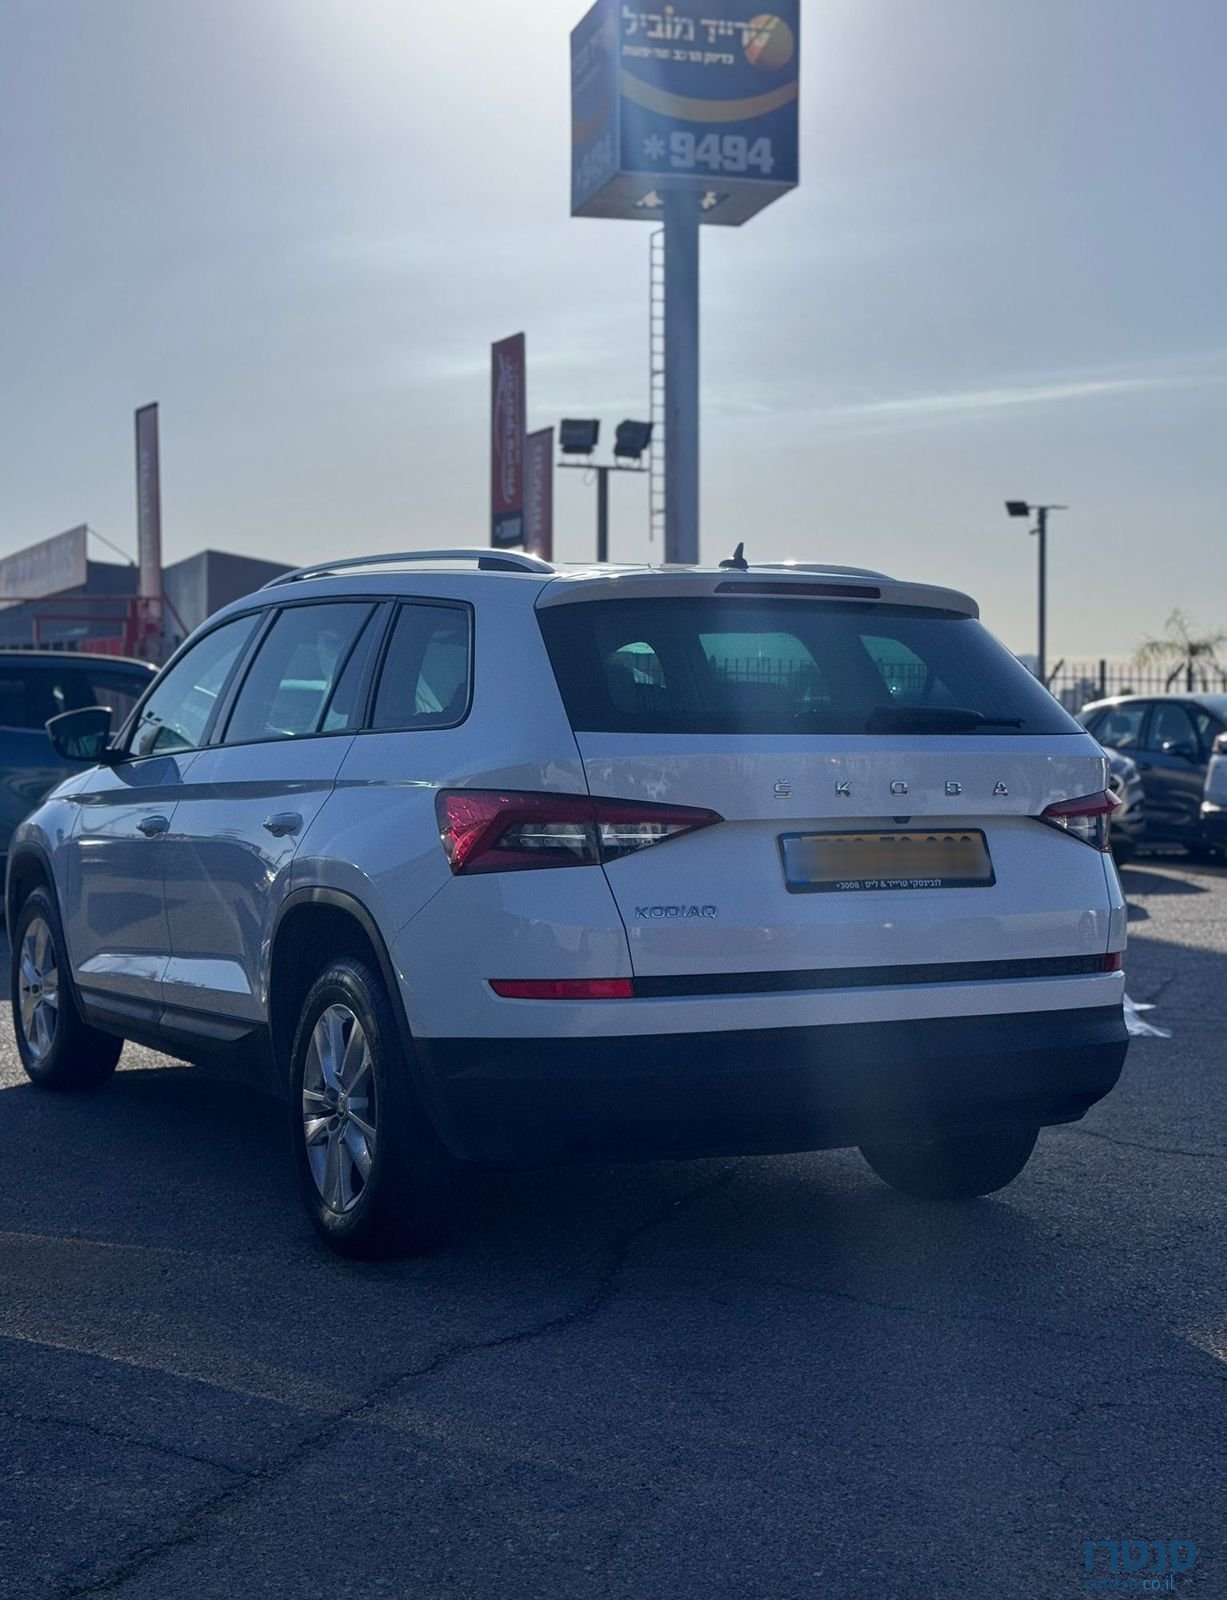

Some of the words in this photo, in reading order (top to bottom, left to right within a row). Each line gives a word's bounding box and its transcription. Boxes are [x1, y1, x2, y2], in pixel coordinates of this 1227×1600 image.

[622, 5, 695, 42] מוביל
[773, 778, 1010, 799] ŠKODA
[887, 880, 909, 888] טרייד
[910, 879, 942, 888] לובינסקי
[635, 905, 718, 919] KODIAQ
